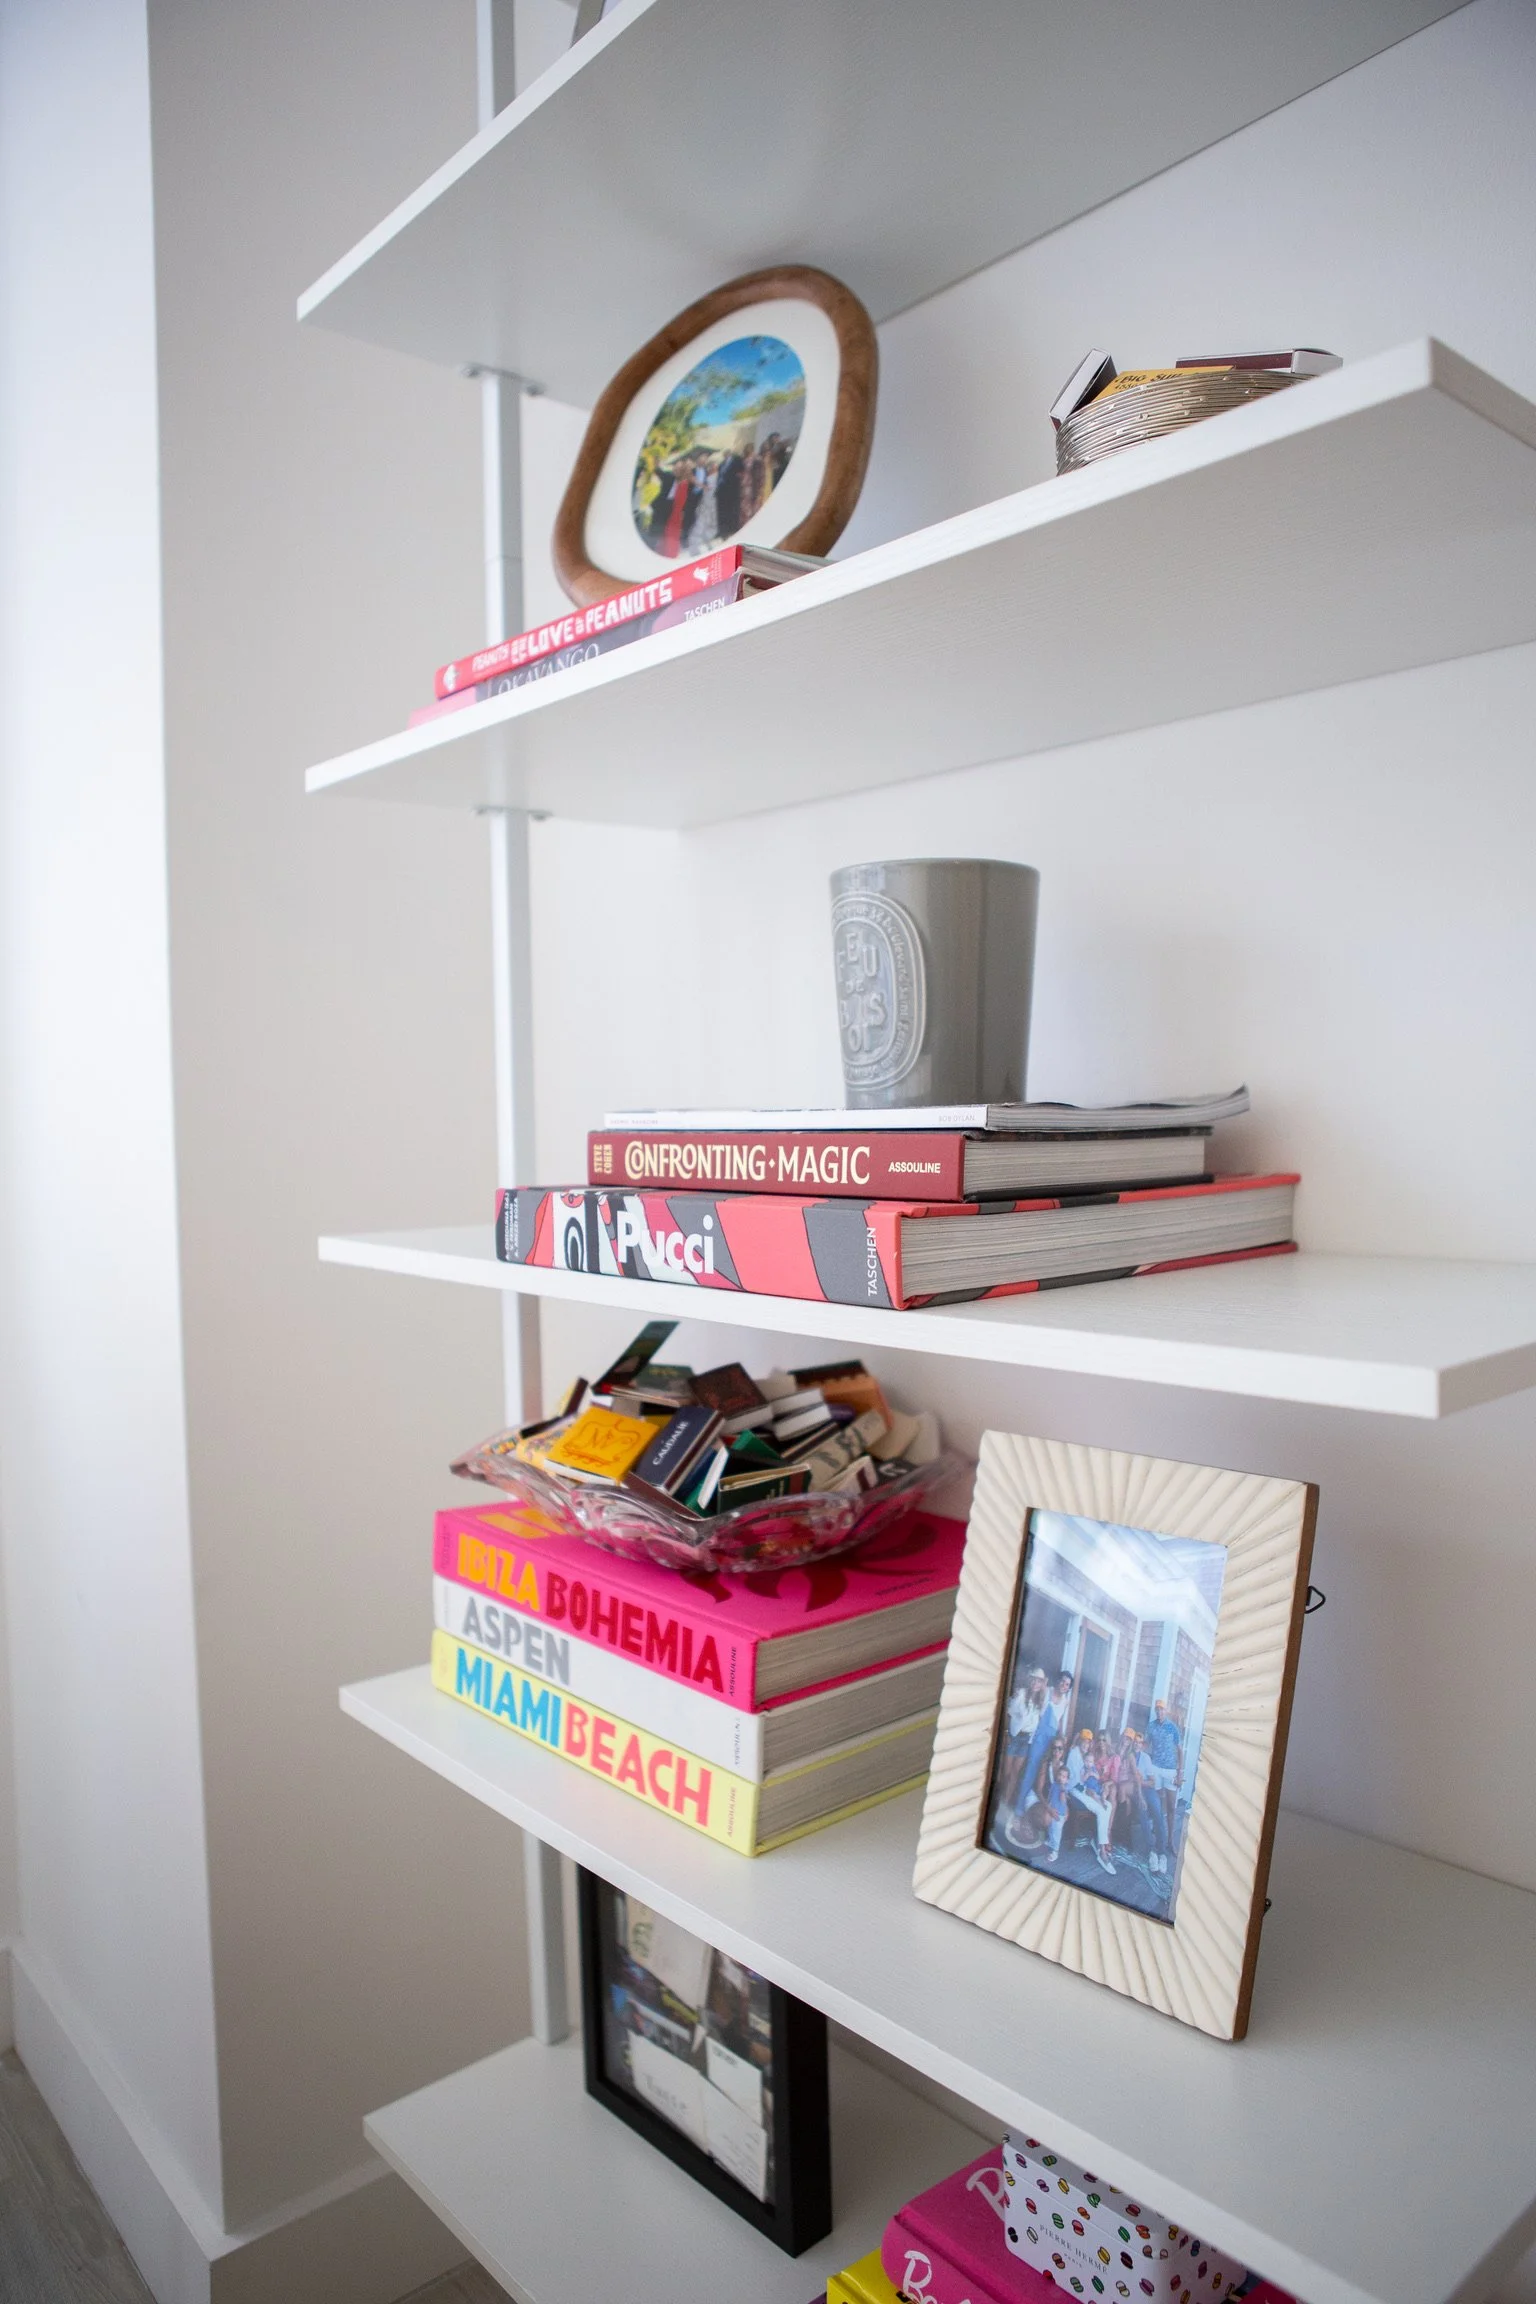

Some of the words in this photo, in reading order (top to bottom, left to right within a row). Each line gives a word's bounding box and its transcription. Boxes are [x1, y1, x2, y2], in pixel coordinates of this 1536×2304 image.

[585, 577, 673, 634] PEANUTS
[684, 596, 725, 622] TASCHEN
[528, 618, 575, 655] LOVE
[498, 643, 600, 696] OKAVANGO
[593, 1144, 603, 1173] STEVE
[603, 1144, 613, 1174] COHEN
[778, 1145, 870, 1185] MAGIC
[888, 1161, 941, 1174] ASSOULINE
[616, 1211, 714, 1274] Pucci
[867, 1227, 878, 1297] TASCHEN
[457, 1532, 540, 1613] IBIZA
[462, 1596, 571, 1686] ASPEN
[545, 1570, 724, 1694] BOHEMIA
[729, 1645, 738, 1697] ASSOULINE
[455, 1647, 562, 1749] MIAMI
[563, 1701, 713, 1828] BEACH
[726, 1786, 737, 1838] ASSOULINE
[1040, 2224, 1072, 2251] PIERRE
